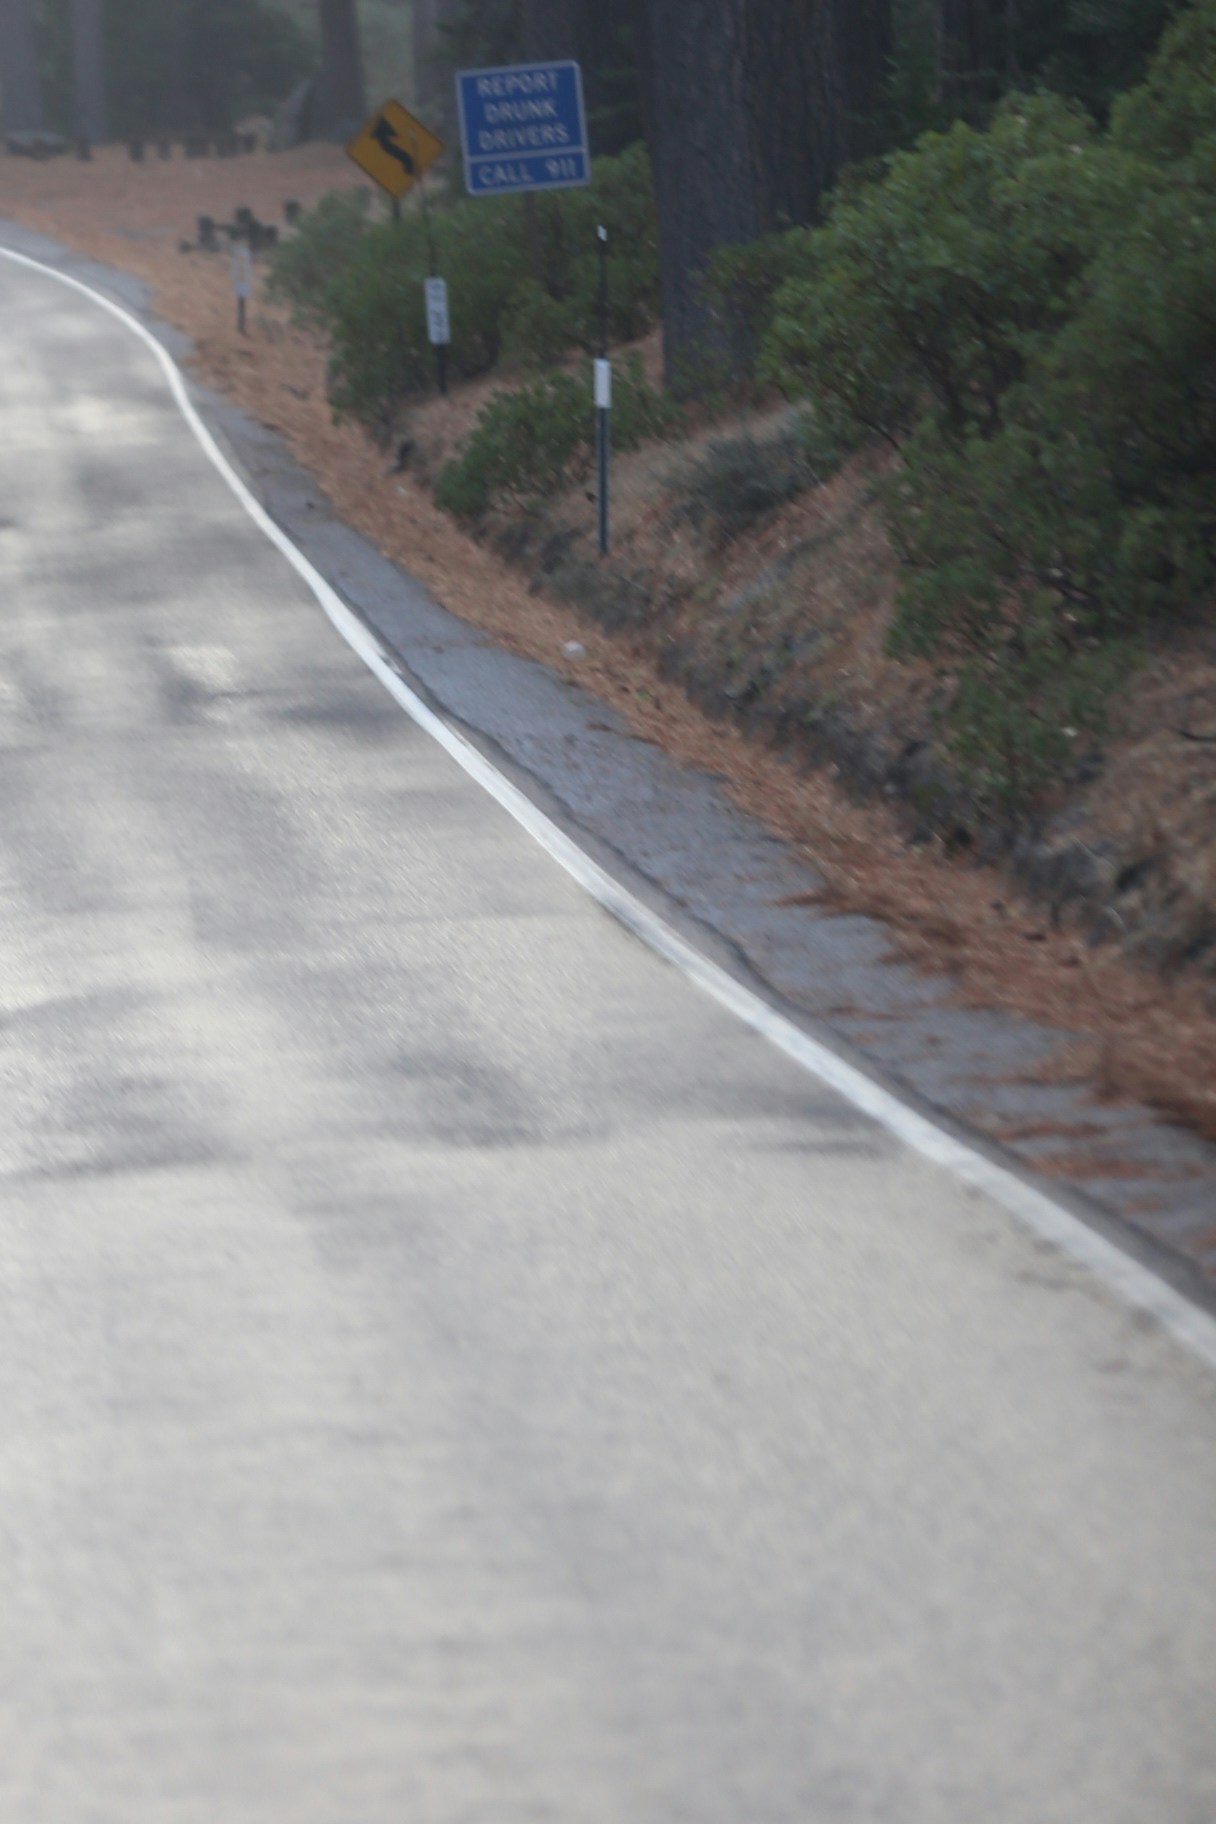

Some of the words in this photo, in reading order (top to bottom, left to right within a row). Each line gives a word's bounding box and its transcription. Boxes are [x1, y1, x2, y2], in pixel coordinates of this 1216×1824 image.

[477, 70, 558, 96] REPORT
[486, 97, 557, 123] DRUNK
[479, 123, 569, 150] DRIVERS
[480, 162, 533, 185] CALL
[546, 158, 576, 178] 911
